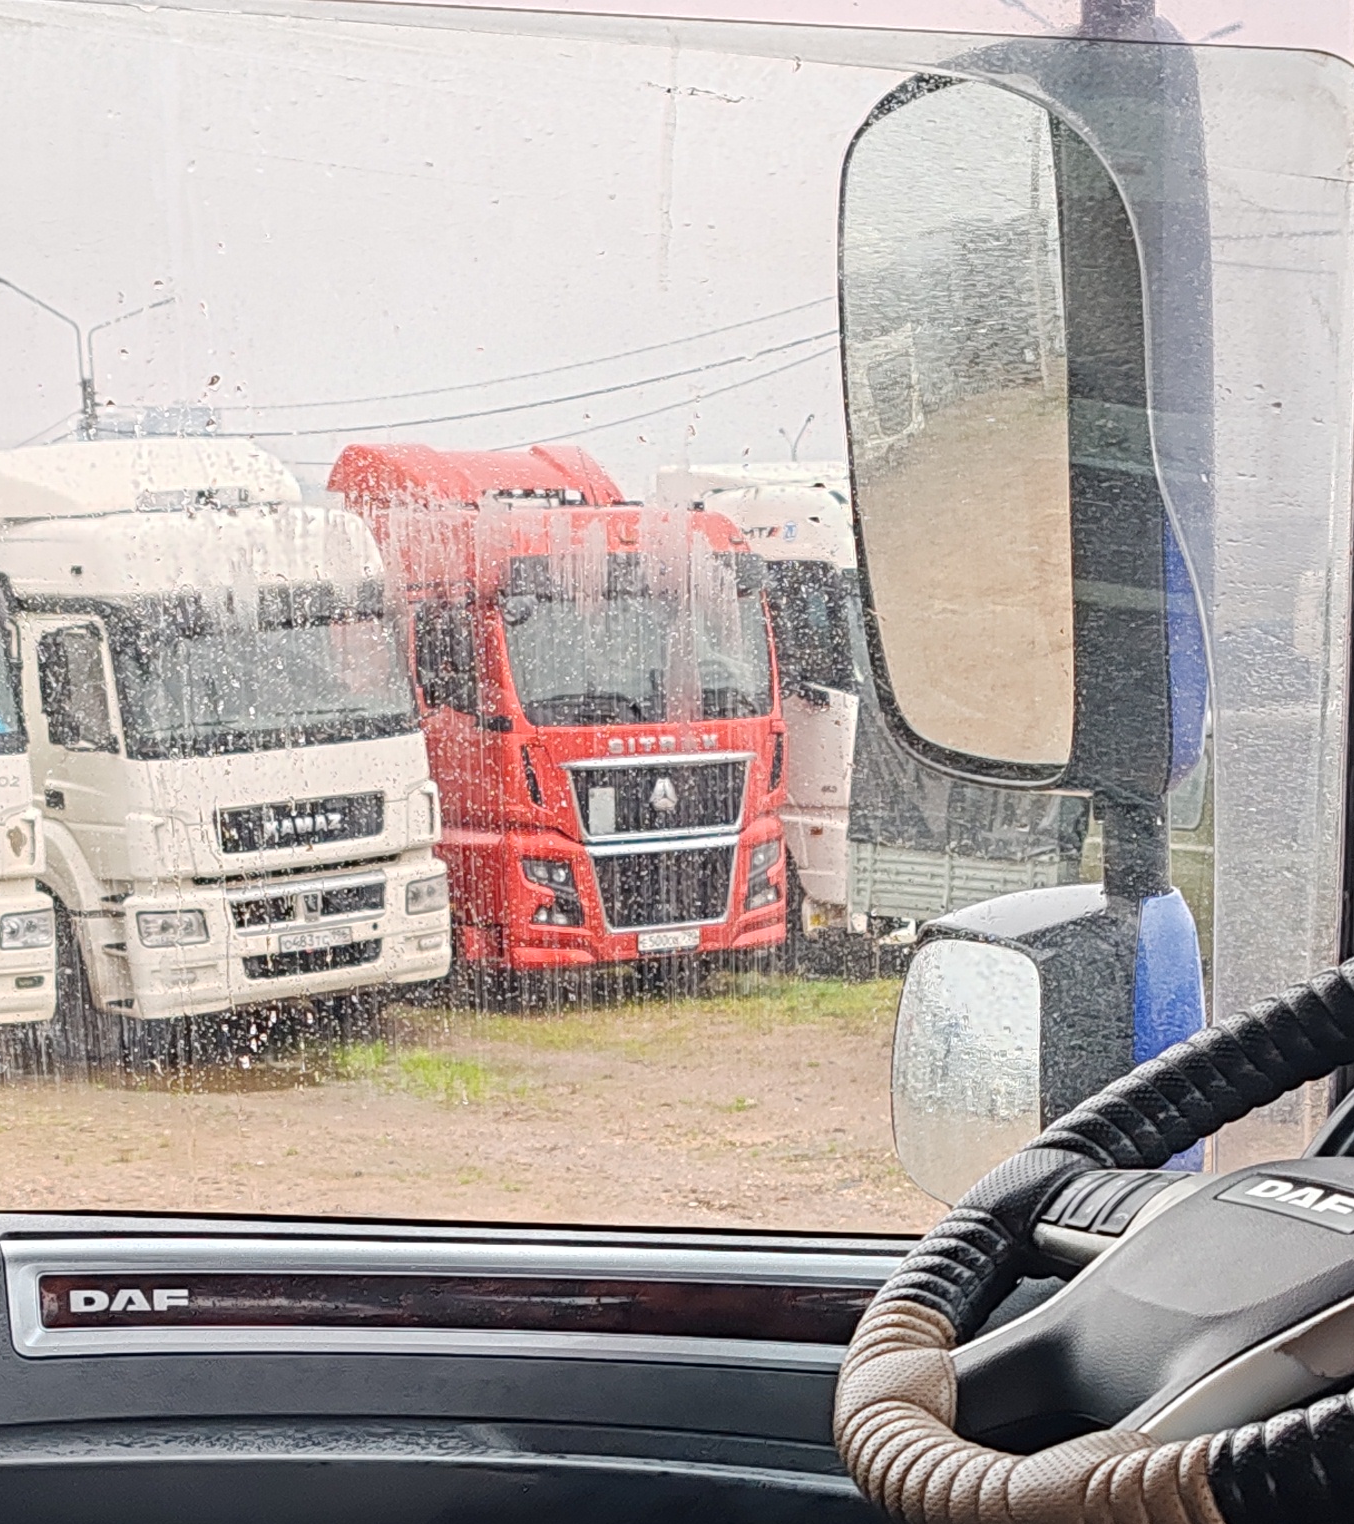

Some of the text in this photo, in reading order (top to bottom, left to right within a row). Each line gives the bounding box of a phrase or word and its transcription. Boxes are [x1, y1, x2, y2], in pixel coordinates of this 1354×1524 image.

[608, 733, 718, 754] SITRK
[264, 813, 342, 840] KAMAZ
[70, 1288, 189, 1312] DAF
